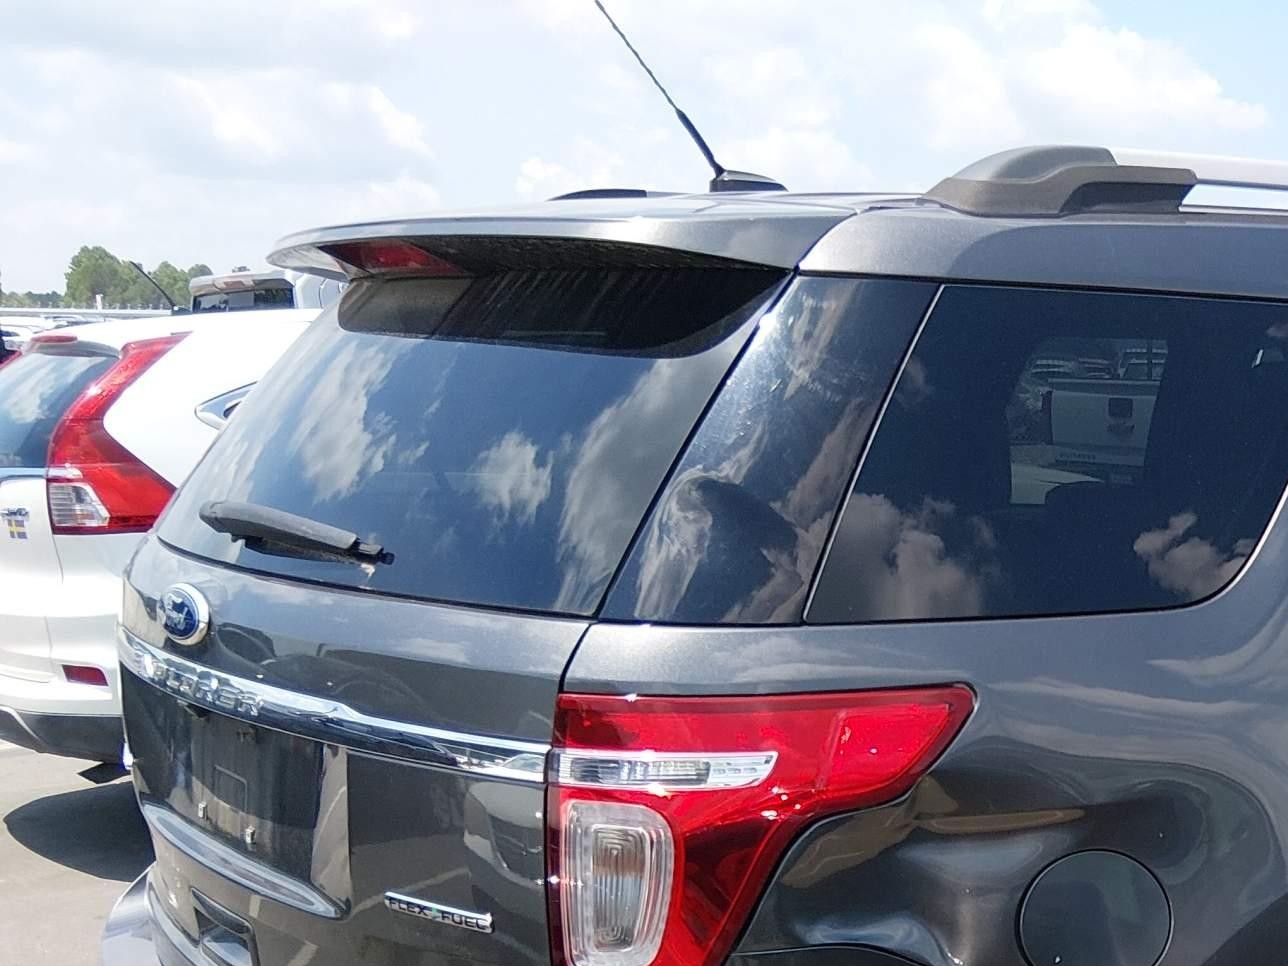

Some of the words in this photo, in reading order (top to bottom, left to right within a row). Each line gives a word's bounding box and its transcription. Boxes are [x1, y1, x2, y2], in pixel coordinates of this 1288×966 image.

[131, 648, 265, 716] EPLORER
[389, 898, 430, 917] FLEX
[440, 910, 491, 931] FUEL
